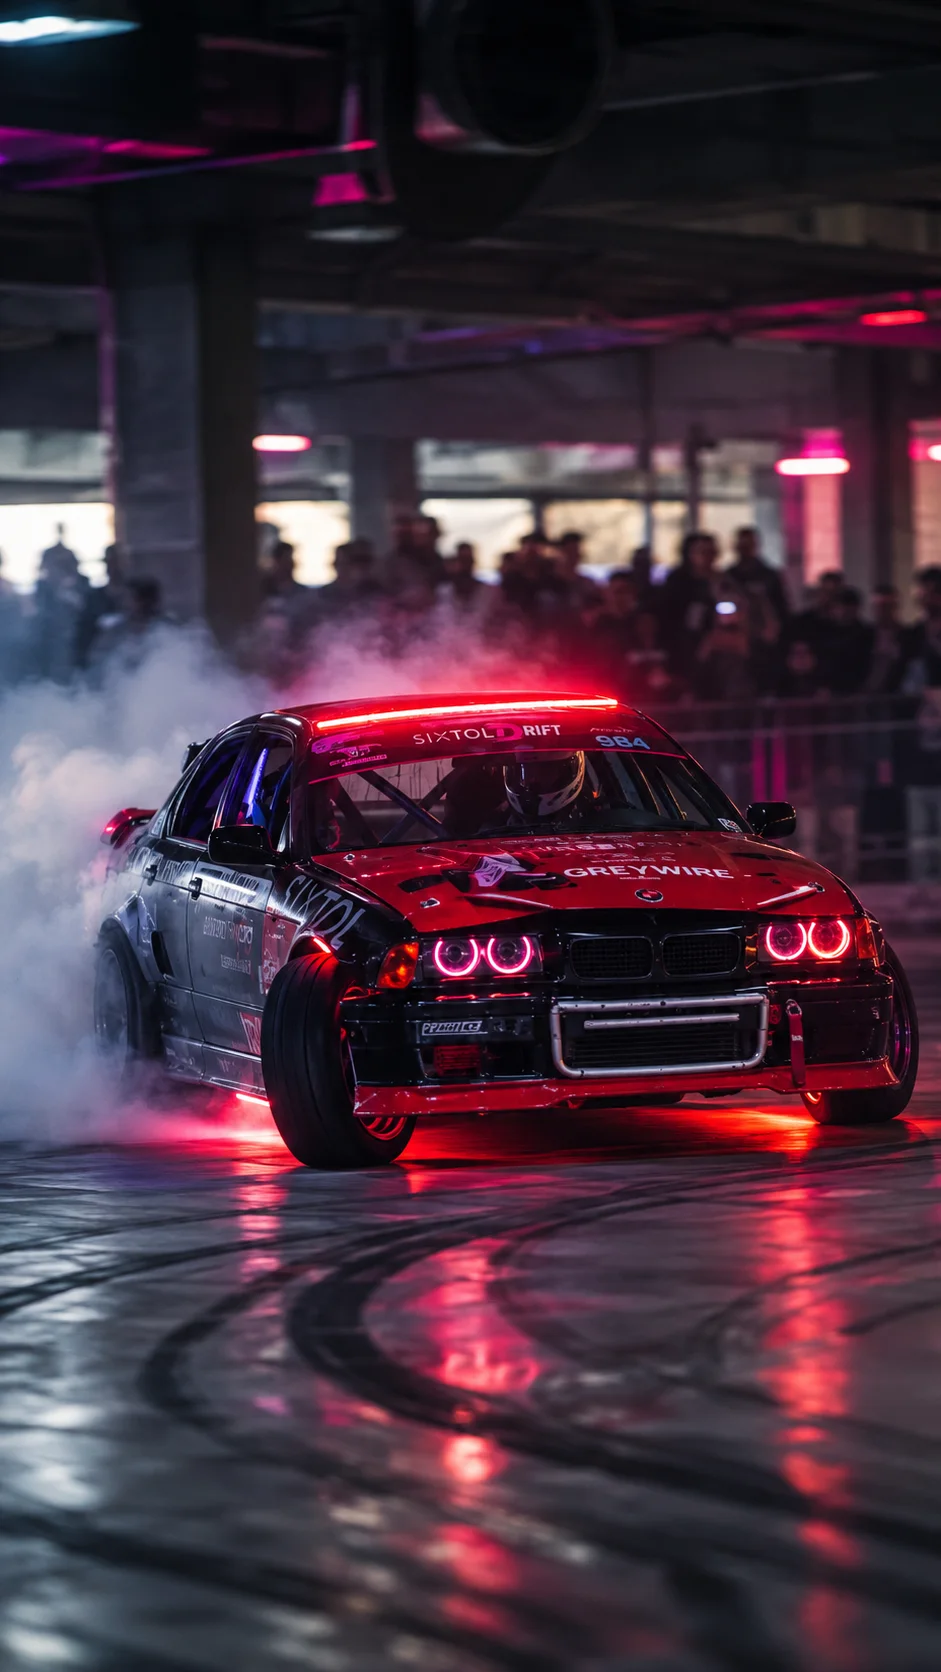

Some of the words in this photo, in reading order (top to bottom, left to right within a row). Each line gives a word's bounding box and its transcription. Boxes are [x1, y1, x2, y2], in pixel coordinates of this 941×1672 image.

[413, 728, 494, 745] SIXTOL
[595, 735, 651, 750] 984
[563, 865, 735, 879] GREYWIRE
[281, 875, 366, 951] SIXTOL
